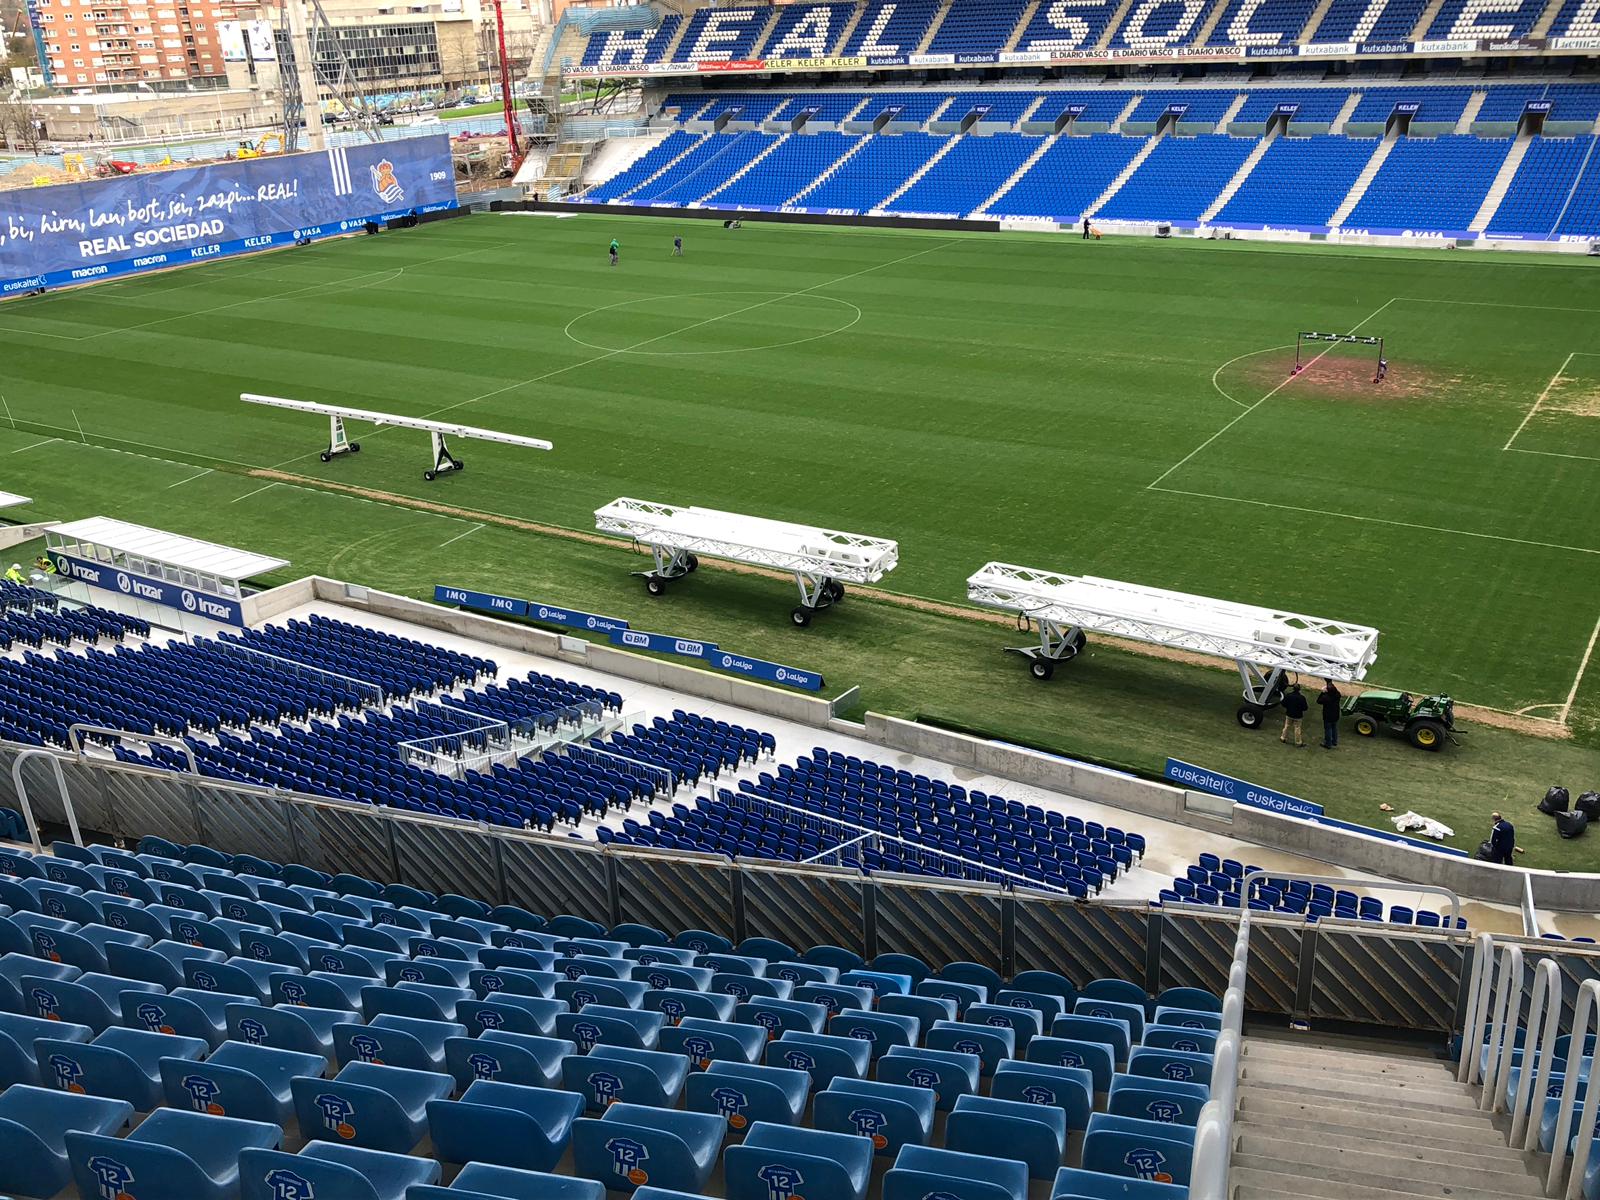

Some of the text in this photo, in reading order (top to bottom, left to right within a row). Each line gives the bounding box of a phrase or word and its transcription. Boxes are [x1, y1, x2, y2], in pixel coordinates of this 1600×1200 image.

[1306, 46, 1349, 54] kutxabank
[1362, 44, 1408, 52] kutxabank
[1421, 42, 1468, 50] kutxabank
[1251, 47, 1294, 56] kutxabank
[798, 58, 826, 66] KELER
[832, 58, 860, 66] KELER
[914, 56, 949, 64] kutxabank
[959, 54, 994, 62] kutxabank
[1004, 53, 1040, 61] kutxabank
[764, 60, 792, 68] KELER
[430, 171, 446, 182] 1909
[258, 178, 298, 202] REAL!
[348, 218, 368, 228] VASA
[302, 226, 322, 237] VASA
[1414, 231, 1444, 239] VASA
[79, 219, 224, 258] REAL SOCIEDAD
[244, 235, 272, 248] KELER
[191, 244, 220, 258] KELER
[134, 254, 166, 267] macron
[72, 265, 108, 278] macron
[4, 276, 39, 292] euskaltel
[446, 590, 466, 602] IMQ
[492, 598, 512, 611] IMQ
[548, 610, 566, 620] LaLiga
[633, 634, 648, 644] BM
[686, 643, 700, 654] BM
[732, 660, 752, 670] LaLiga
[786, 672, 808, 684] LaLiga
[1170, 766, 1224, 791] euskaltel
[184, 929, 192, 938] 12
[42, 939, 49, 948] 12
[257, 948, 265, 956] 12
[327, 961, 336, 970] 12
[200, 978, 209, 988] 12
[487, 981, 496, 990] 12
[655, 978, 664, 986] 12
[288, 988, 298, 998] 12
[38, 997, 50, 1008] 12
[666, 1006, 678, 1014] 12
[149, 1012, 158, 1022] 12
[484, 1017, 494, 1026] 12
[762, 1019, 773, 1028] 12
[246, 1028, 257, 1039] 12
[582, 1030, 592, 1040] 12
[360, 1043, 371, 1054] 12
[693, 1044, 704, 1054] 12
[476, 1062, 490, 1074] 12
[793, 1058, 806, 1069] 12
[1062, 1058, 1074, 1068] 12
[58, 1063, 70, 1074] 12
[1172, 1069, 1184, 1079] 12
[917, 1076, 930, 1086] 12
[192, 1085, 208, 1098] 12
[598, 1081, 612, 1092] 12
[722, 1096, 736, 1108] 12
[1032, 1094, 1045, 1104] 12
[325, 1103, 340, 1116] 12
[1156, 1108, 1170, 1118] 12
[860, 1118, 875, 1130] 12
[618, 1148, 634, 1162] 12
[1136, 1158, 1154, 1170] 12
[100, 1168, 118, 1184] 12
[772, 1174, 790, 1188] 12
[278, 1183, 297, 1200] 12
